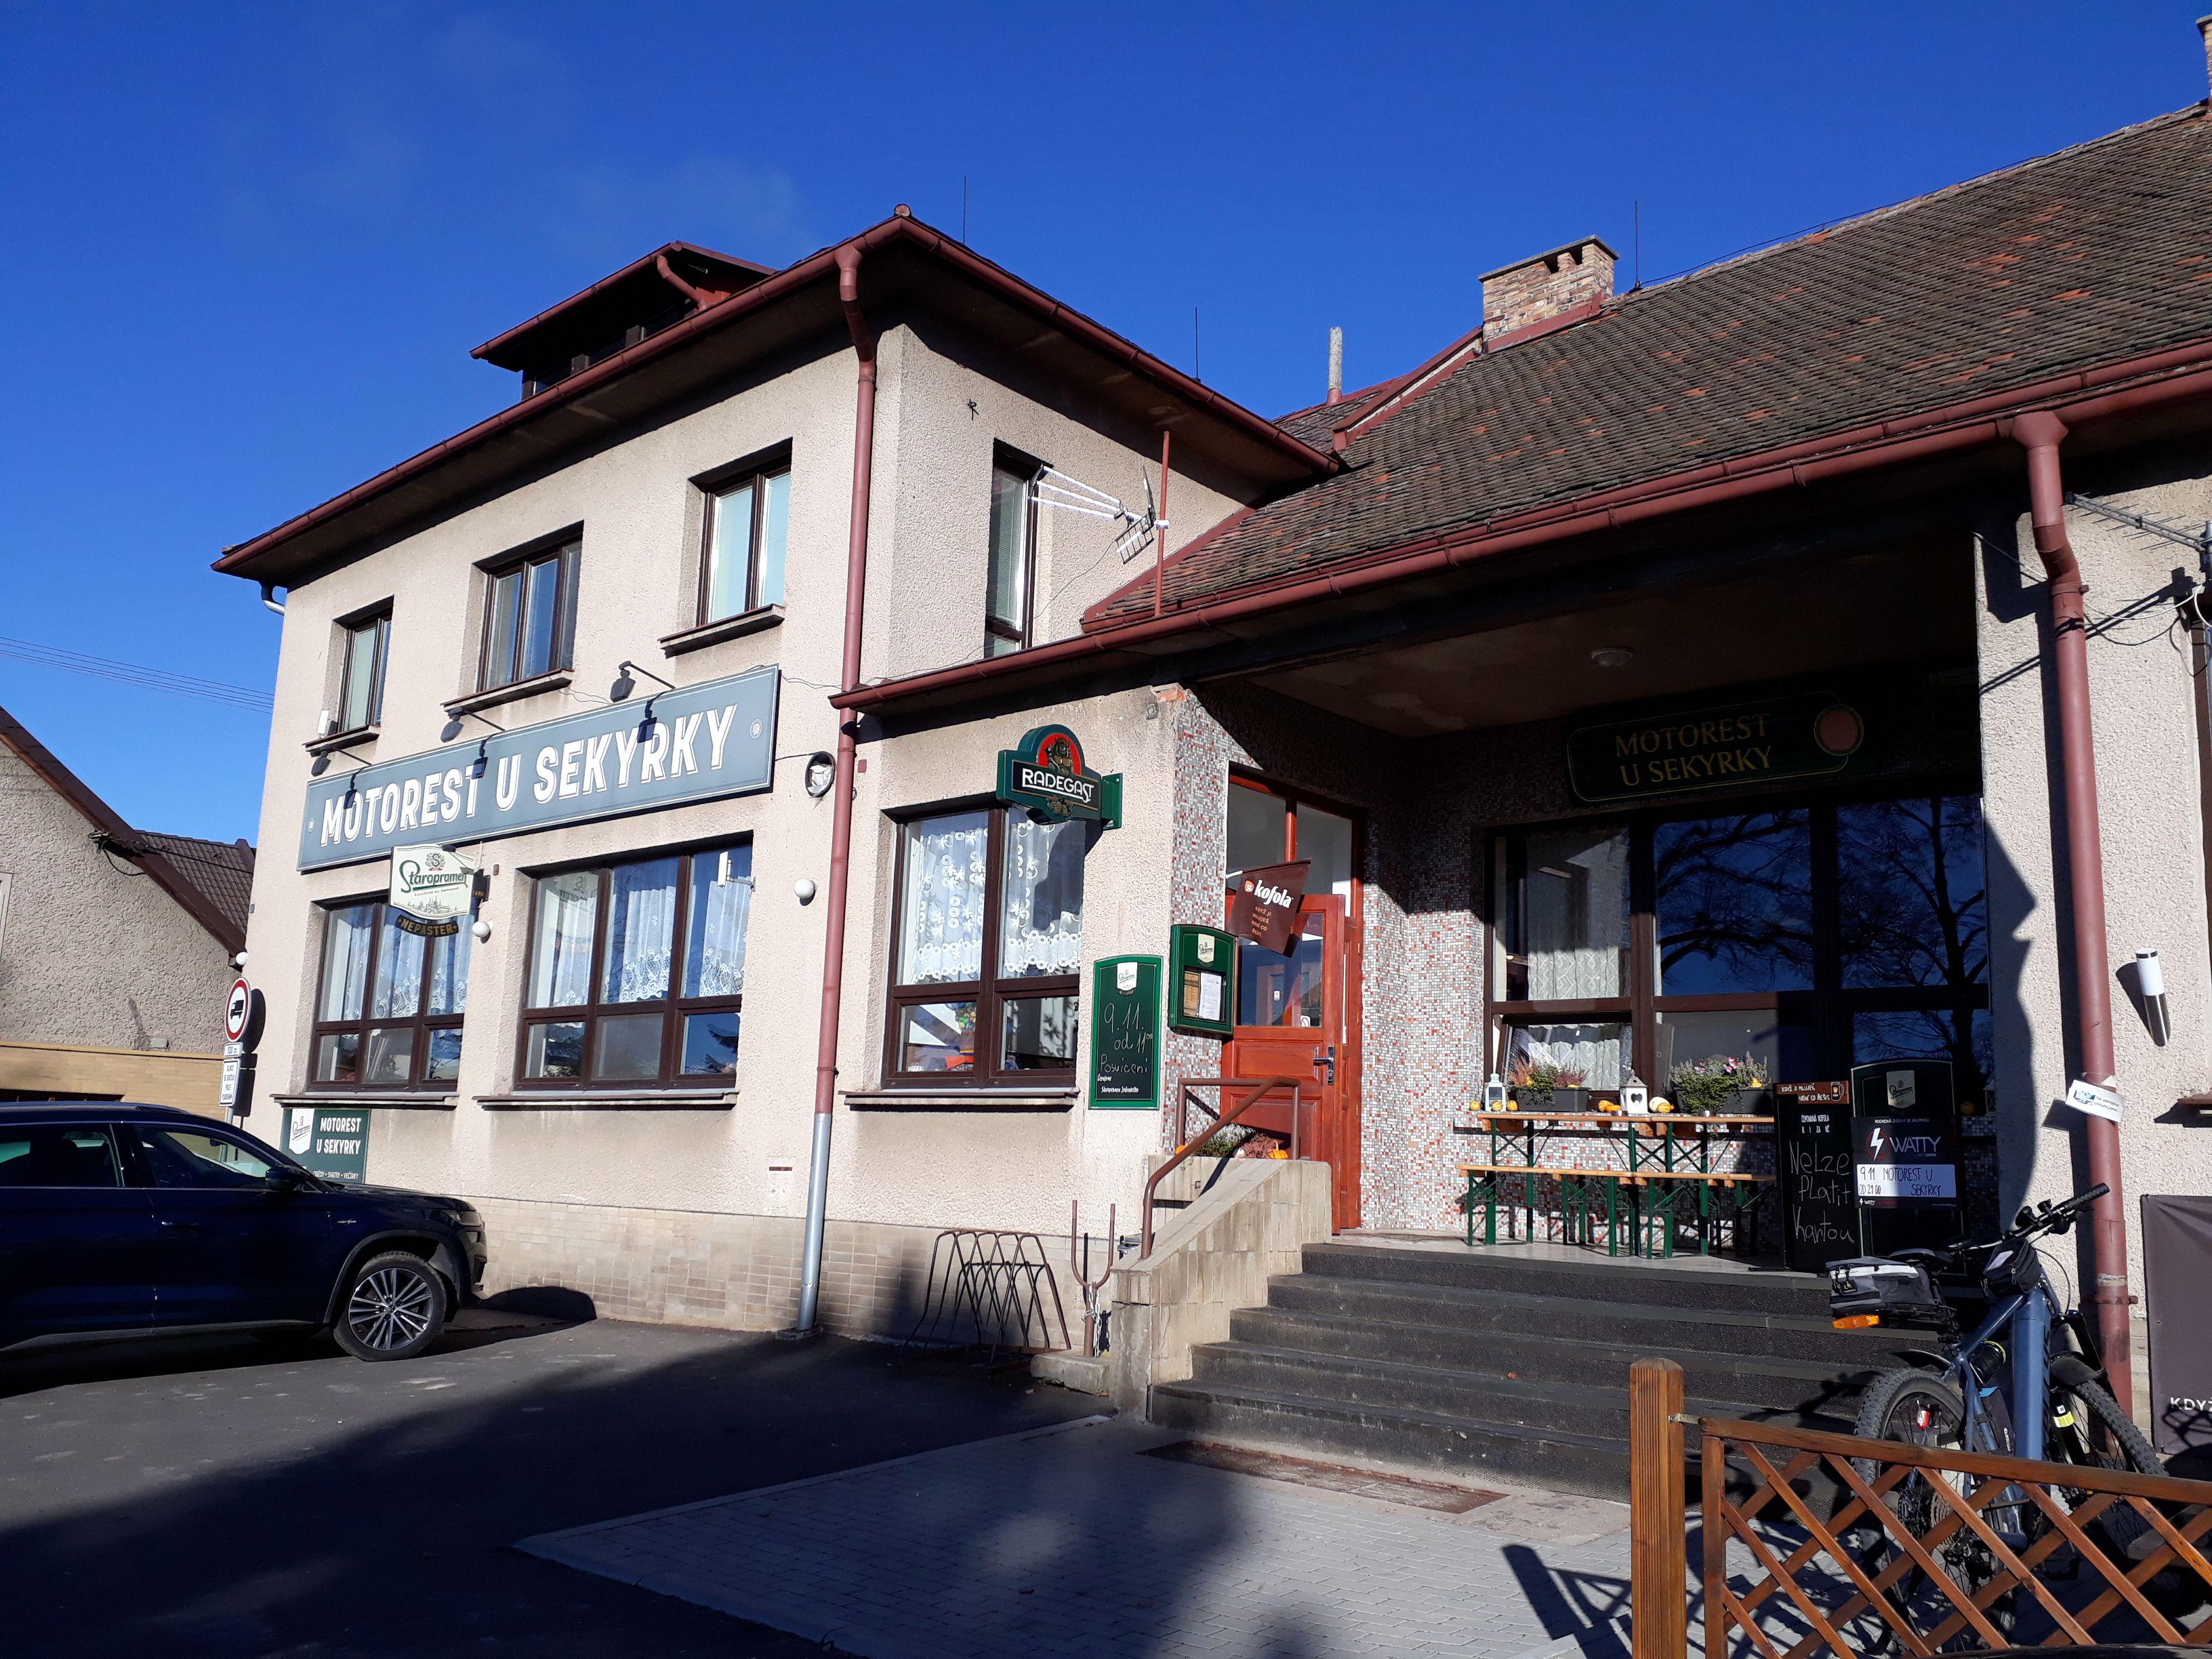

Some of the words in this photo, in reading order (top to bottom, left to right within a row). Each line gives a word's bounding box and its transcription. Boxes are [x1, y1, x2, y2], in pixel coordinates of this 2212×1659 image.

[1615, 712, 1770, 757] MOTOREST
[321, 763, 485, 848] MOTOREST
[496, 754, 522, 811] U
[533, 703, 737, 804] SEKYRKY
[1619, 763, 1641, 786] U
[1647, 744, 1773, 783] SEKYRKY
[1021, 768, 1094, 803] RADEGAST
[399, 860, 468, 893] Staropramen
[1254, 879, 1292, 909] kofola
[1113, 1031, 1133, 1050] od
[320, 1117, 362, 1133] MOTOREST
[316, 1139, 322, 1153] U
[323, 1139, 361, 1155] SEKYRKY
[1889, 1136, 1942, 1153] WATTY
[1883, 1167, 1922, 1181] MOTOREST
[1925, 1169, 1933, 1182] U
[1910, 1183, 1942, 1196] SEKYRKY
